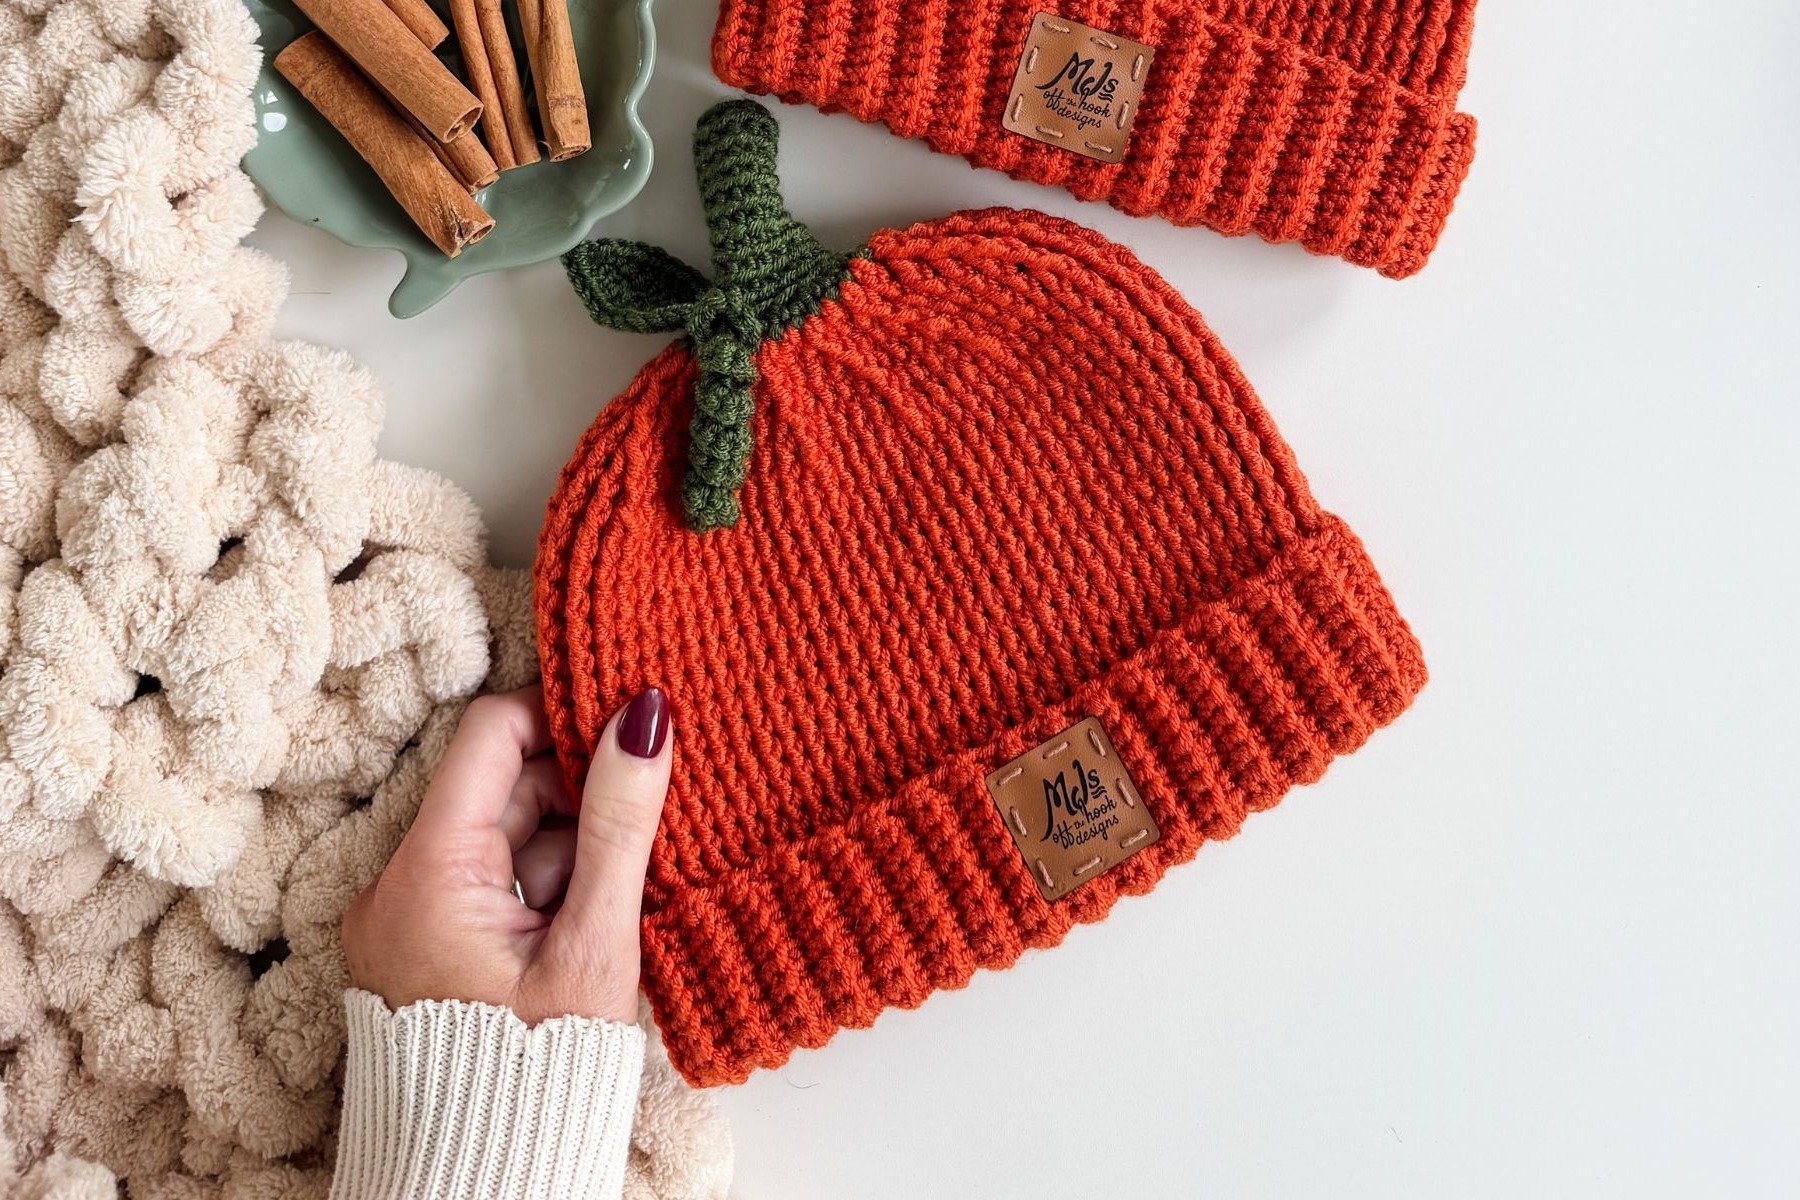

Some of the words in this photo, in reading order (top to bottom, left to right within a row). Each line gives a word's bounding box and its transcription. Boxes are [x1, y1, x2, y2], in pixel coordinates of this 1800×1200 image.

[1043, 88, 1067, 110] off
[1067, 97, 1077, 107] the
[1079, 89, 1111, 118] hook
[1057, 106, 1102, 130] designs
[1078, 795, 1118, 823] hook
[1052, 820, 1075, 849] off
[1074, 819, 1085, 829] the
[1075, 814, 1120, 846] designs
